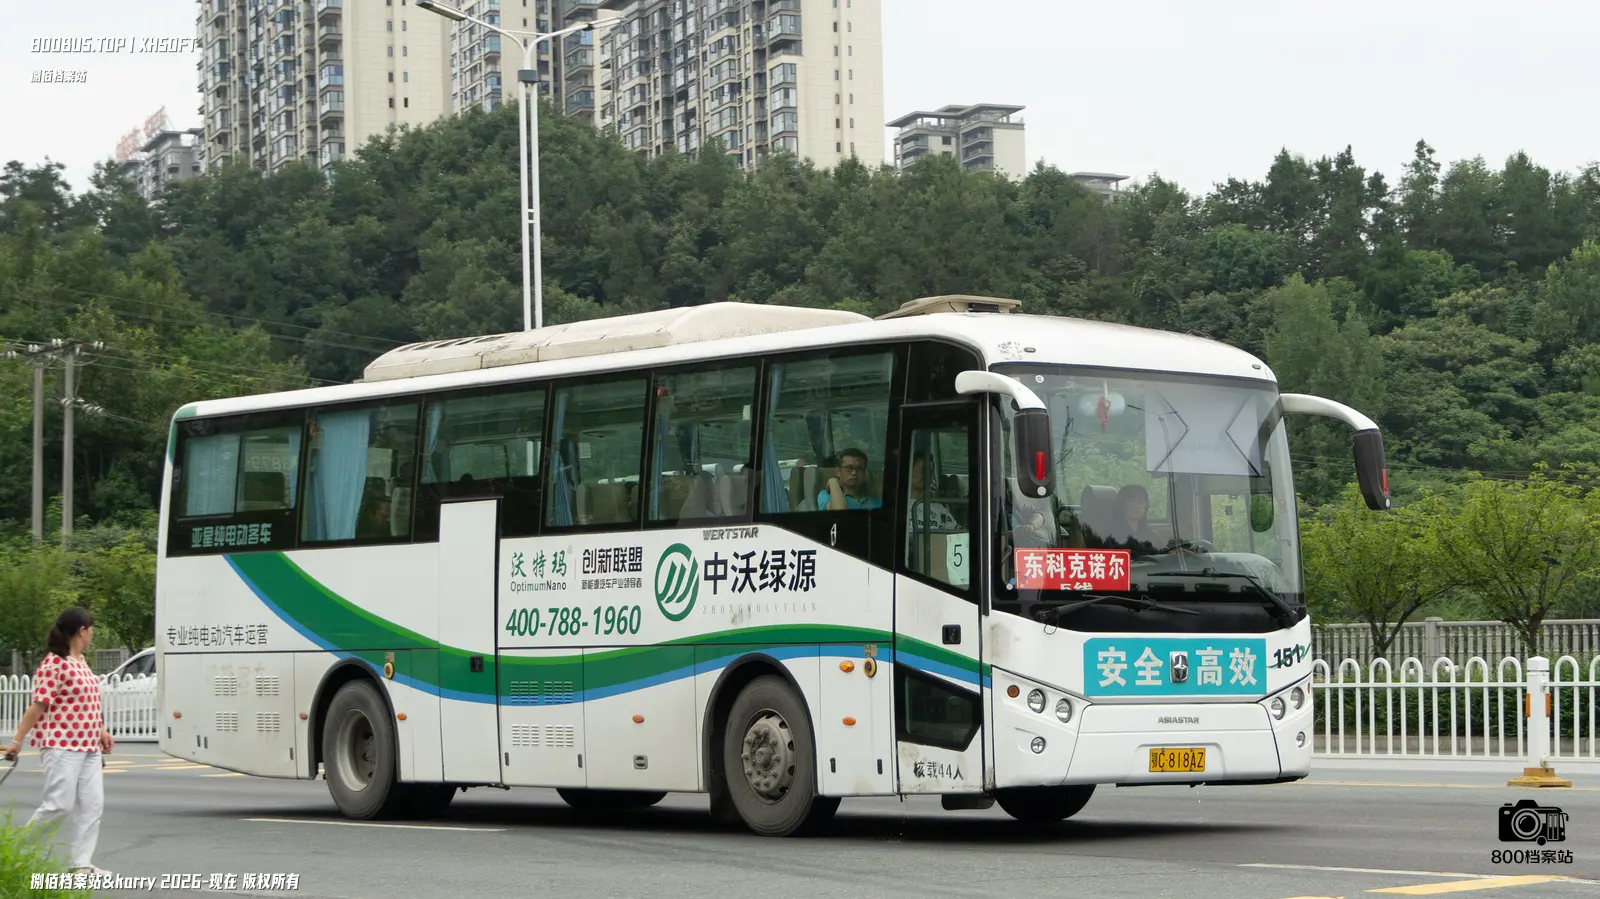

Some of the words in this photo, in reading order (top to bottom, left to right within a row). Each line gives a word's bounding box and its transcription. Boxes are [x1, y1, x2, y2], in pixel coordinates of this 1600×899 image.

[191, 523, 272, 548] 亚星纯电动客车
[702, 526, 759, 541] WERTSTAR
[583, 546, 643, 575] 创新联盟
[953, 544, 963, 567] 5
[1023, 552, 1125, 580] 东科克诺尔
[703, 549, 817, 596] 中沃绿源
[511, 580, 567, 594] OptimumNano
[505, 605, 642, 637] 400-788-1960
[166, 623, 268, 647] 专业纯电动汽车运营
[1096, 646, 1164, 688] 安全
[1194, 647, 1257, 687] 高效
[1157, 716, 1200, 724] ASIASTAR
[913, 761, 964, 780] 核载44人
